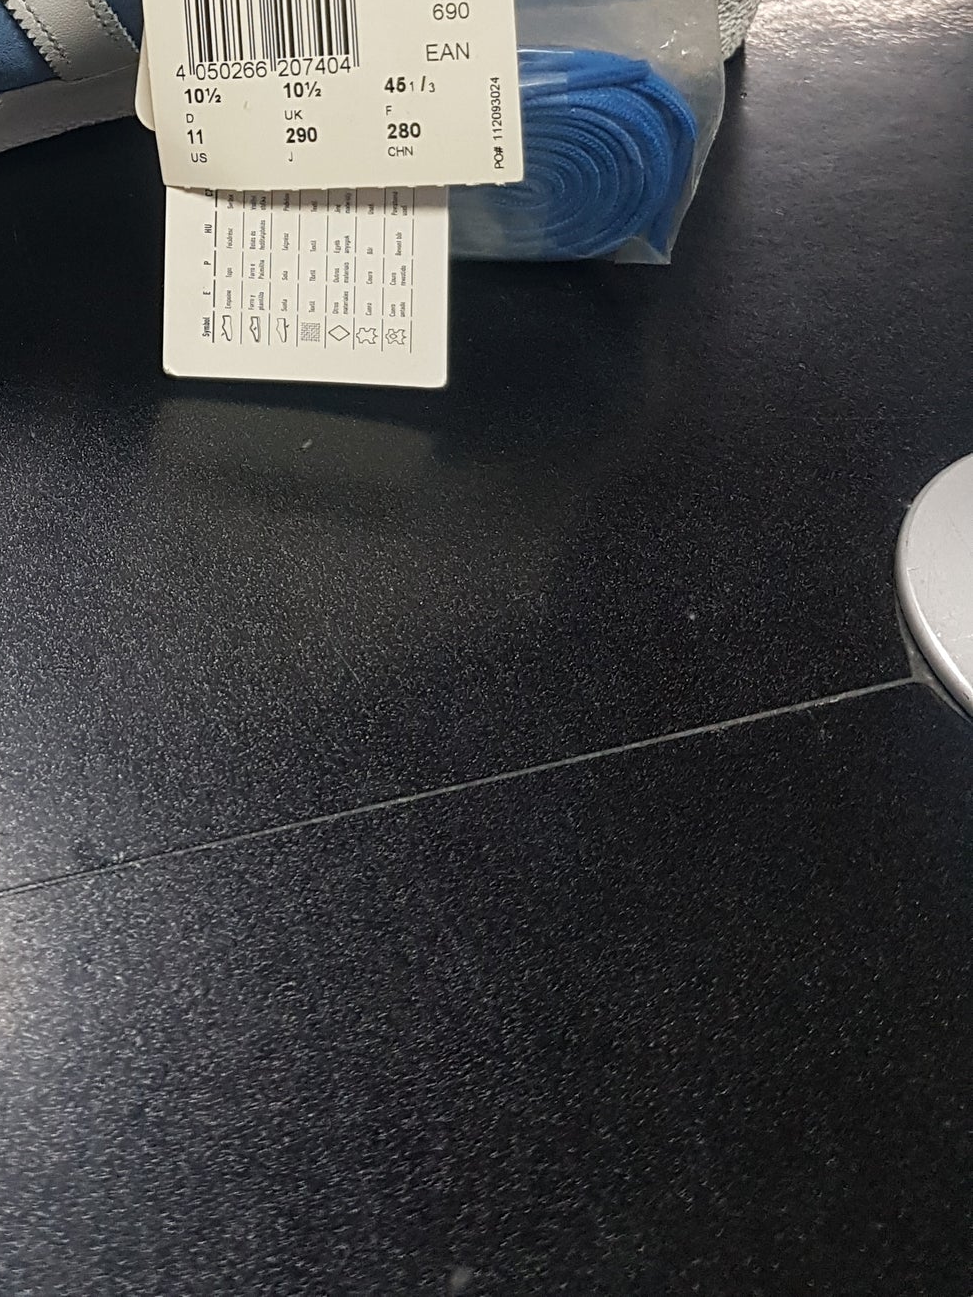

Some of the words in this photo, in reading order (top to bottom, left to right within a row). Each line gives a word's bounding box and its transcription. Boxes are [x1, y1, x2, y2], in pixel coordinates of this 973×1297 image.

[432, 1, 470, 21] 690
[425, 42, 471, 63] EAN
[195, 61, 268, 80] 050266
[277, 56, 352, 77] 207404
[283, 110, 304, 120] UK
[385, 106, 393, 116] F
[490, 76, 503, 142] 112093024
[186, 114, 195, 123] D
[187, 129, 204, 145] 11
[285, 127, 318, 144] 290
[387, 122, 421, 140] 280
[190, 152, 208, 164] US
[387, 146, 414, 157] CHN
[204, 224, 212, 233] HU
[202, 317, 210, 337] Symbol
